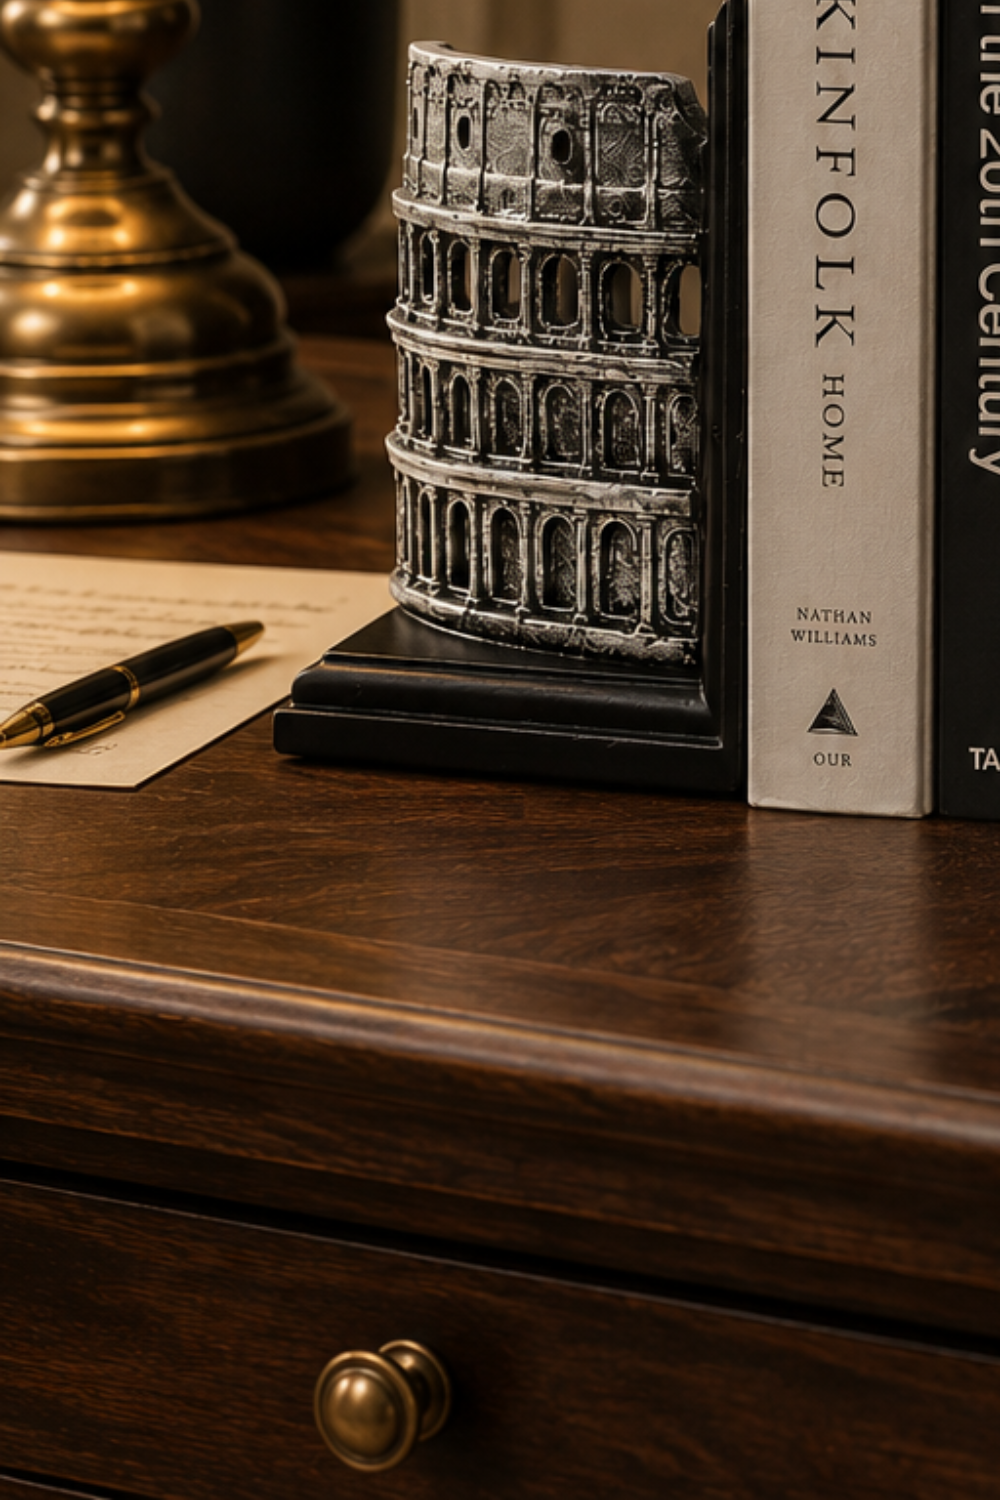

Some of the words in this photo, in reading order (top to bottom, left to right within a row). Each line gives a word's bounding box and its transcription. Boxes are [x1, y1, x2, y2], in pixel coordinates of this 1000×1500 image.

[821, 374, 845, 488] HOME
[796, 607, 872, 624] NATHAN
[790, 629, 877, 647] WILLIAMS
[813, 751, 852, 767] OUR
